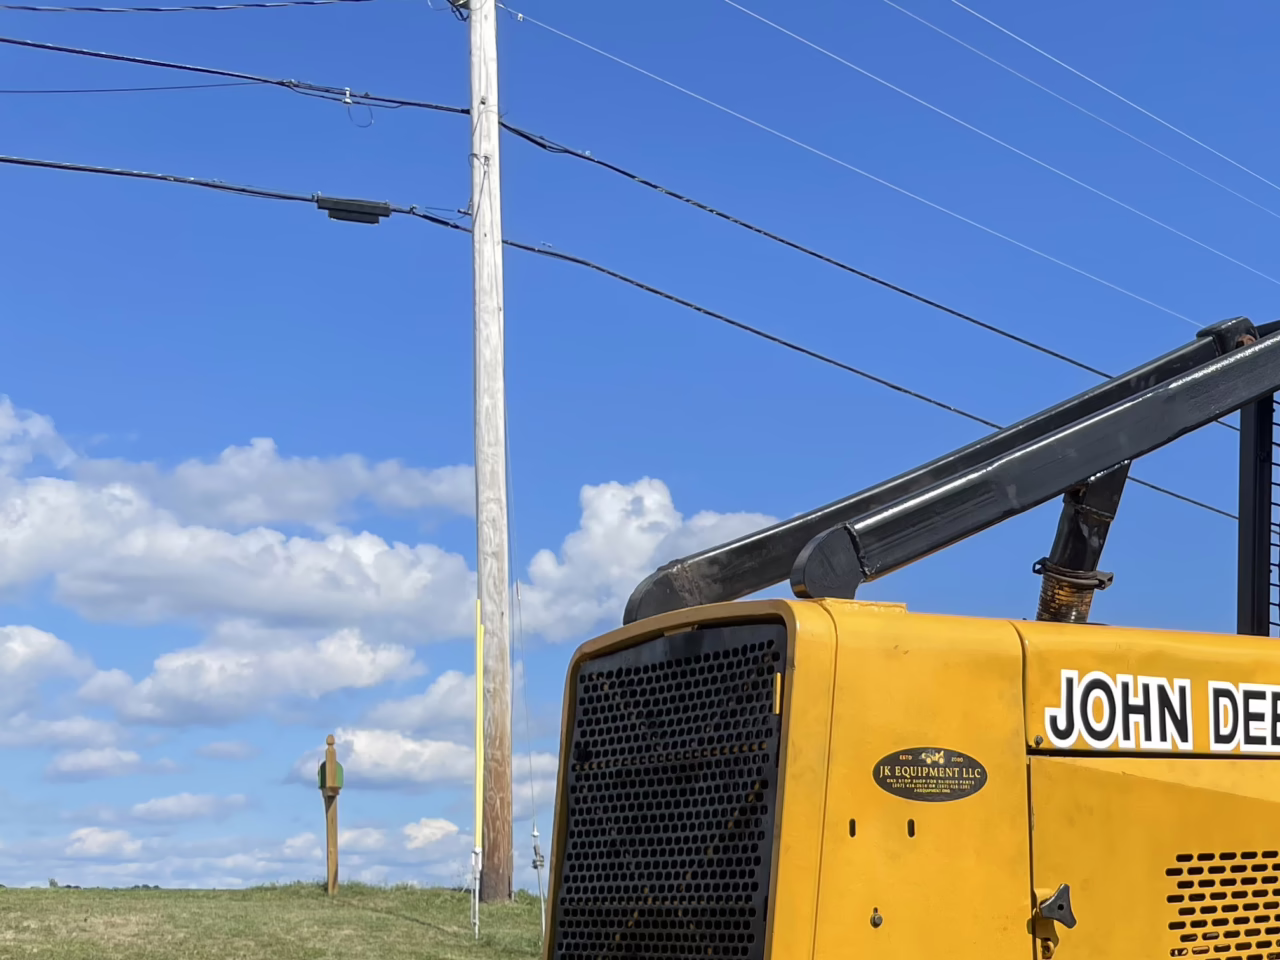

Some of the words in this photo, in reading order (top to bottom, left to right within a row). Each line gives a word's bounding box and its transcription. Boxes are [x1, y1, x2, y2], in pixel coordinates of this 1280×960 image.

[1045, 669, 1193, 750] JOHN
[879, 765, 891, 778] JK
[895, 765, 960, 778] EQUIPMENT
[962, 767, 981, 778] LLC
